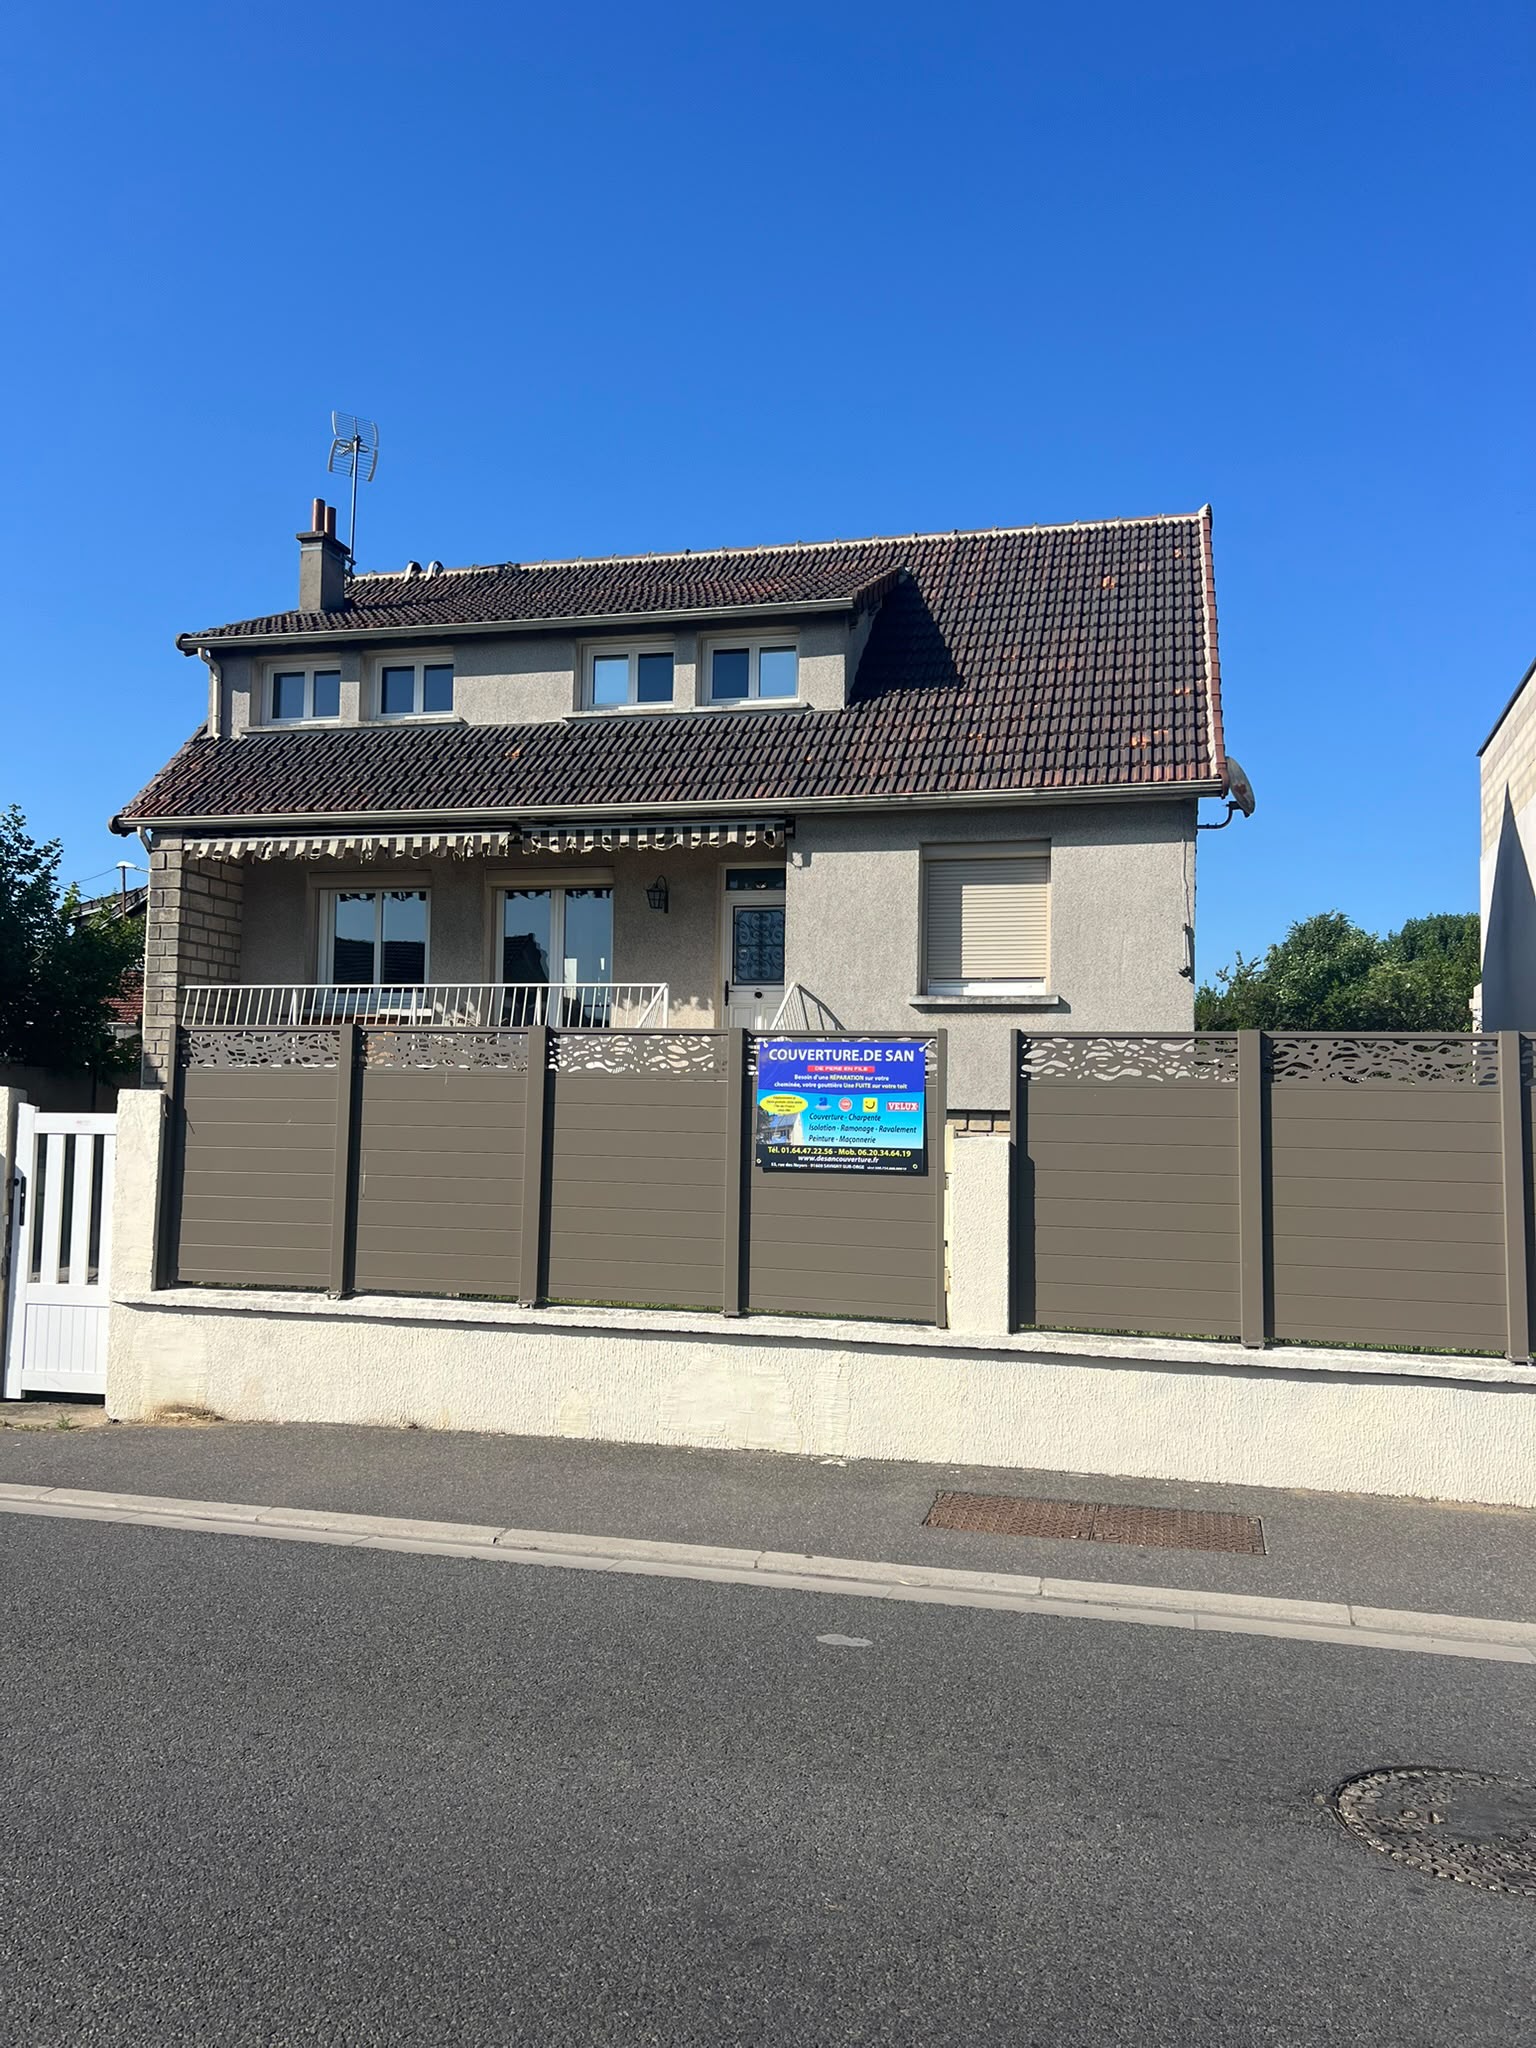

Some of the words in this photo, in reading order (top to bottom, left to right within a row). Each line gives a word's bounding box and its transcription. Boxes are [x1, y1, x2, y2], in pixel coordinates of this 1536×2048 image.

[885, 1049, 915, 1062] SAN
[794, 1073, 812, 1081] Besoin
[888, 1102, 918, 1111] VELUX
[809, 1112, 845, 1121] Couverture
[848, 1113, 882, 1123] Charpente
[808, 1123, 836, 1131] Isolation
[840, 1124, 875, 1134] Ramonage
[878, 1125, 917, 1134] Ravalement
[808, 1134, 835, 1143] Peinture
[838, 1135, 877, 1145] Maçonnerie
[768, 1146, 780, 1154] Tél.
[781, 1147, 833, 1155] 01.64.47.22.56
[838, 1148, 857, 1156] Mob.
[857, 1149, 912, 1157] 06.20.34.64.19
[798, 1155, 879, 1164] www.desancouverture.fr
